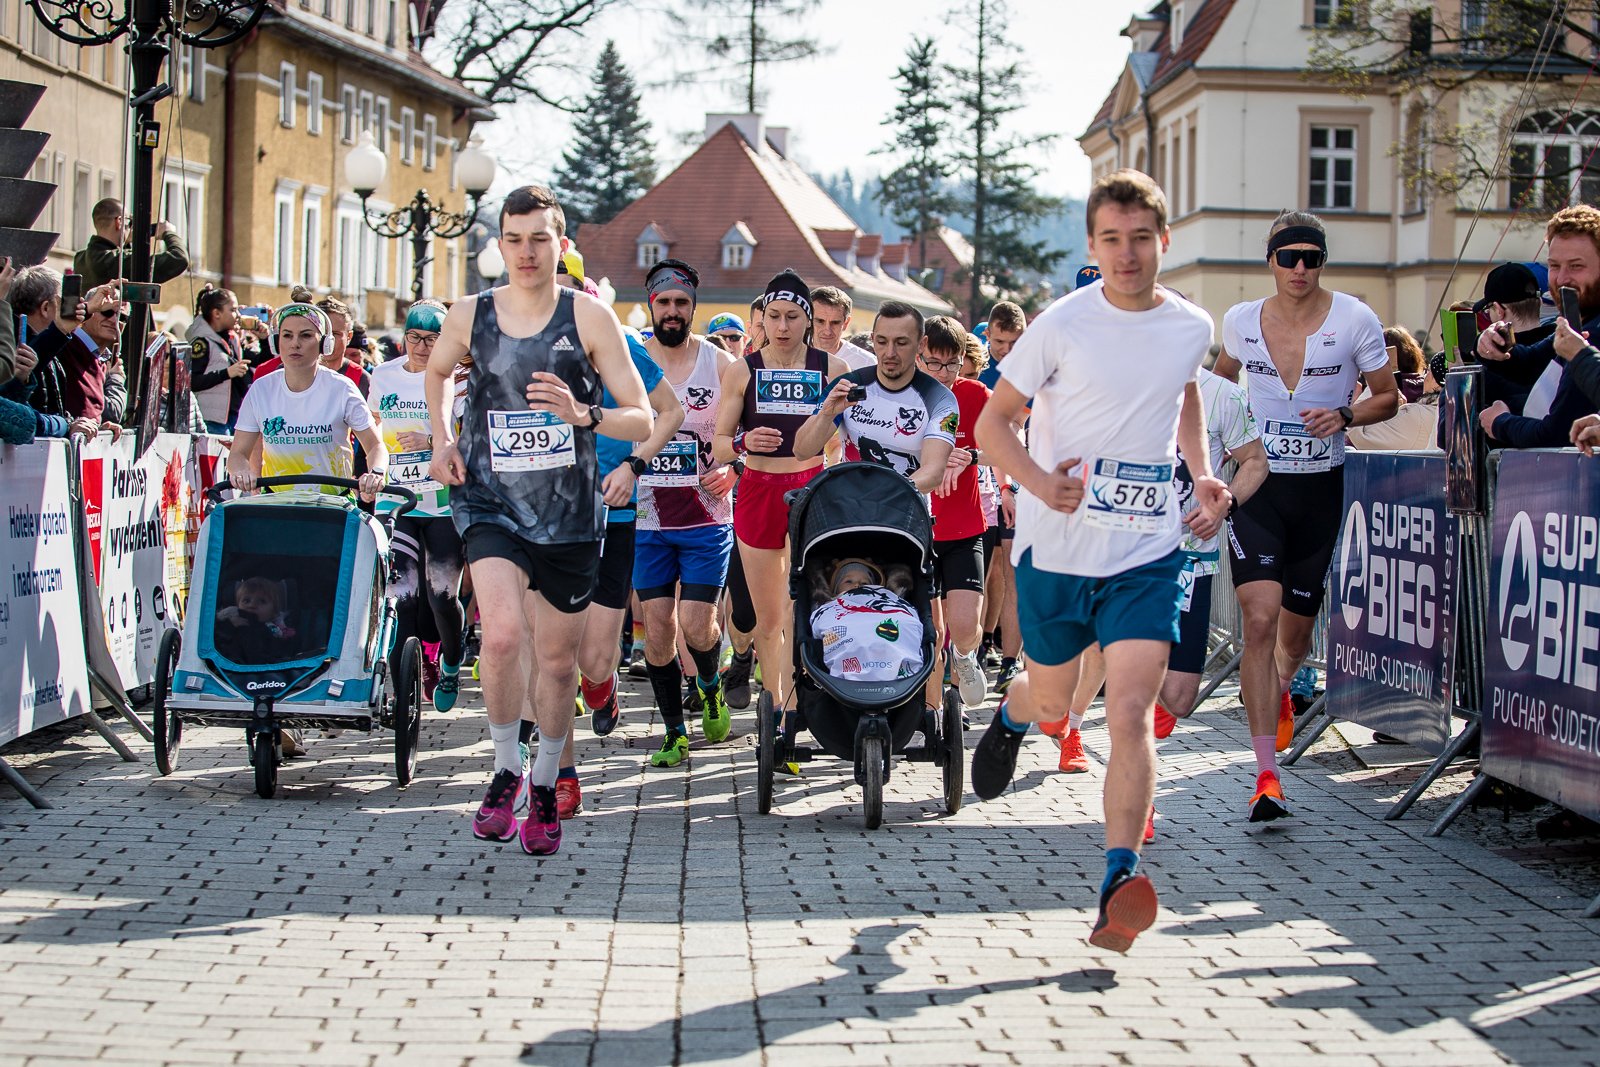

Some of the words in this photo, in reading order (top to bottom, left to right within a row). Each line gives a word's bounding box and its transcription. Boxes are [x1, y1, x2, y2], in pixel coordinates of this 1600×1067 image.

[772, 383, 804, 399] 918
[400, 400, 427, 409] DRUŻY
[410, 412, 430, 420] ENER
[850, 411, 894, 428] Runners
[288, 424, 333, 434] DRUŻYNA
[298, 435, 333, 445] ENERGII
[509, 430, 550, 450] 299
[1279, 438, 1313, 456] 331
[402, 465, 421, 479] 44
[651, 456, 682, 472] 934
[112, 458, 147, 499] Partner
[784, 471, 812, 481] SPORT
[1113, 484, 1157, 508] 578
[9, 504, 34, 539] Hotele
[34, 513, 41, 537] w
[42, 502, 68, 545] górach
[1371, 501, 1435, 555] SUPER
[110, 510, 162, 568] wydarzeni
[1543, 512, 1600, 574] SUP
[12, 563, 17, 598] i
[17, 561, 32, 596] nad
[32, 567, 63, 595] morzem
[1368, 555, 1436, 649] BIEG
[1440, 487, 1454, 728] superbieg.p
[1536, 577, 1600, 692] BIE
[862, 661, 893, 669] MOTOS
[1335, 643, 1377, 682] PUCHAR
[1381, 656, 1434, 700] SUDETÓW
[246, 681, 287, 690] Qeridoo
[1493, 686, 1546, 736] PUCHAR
